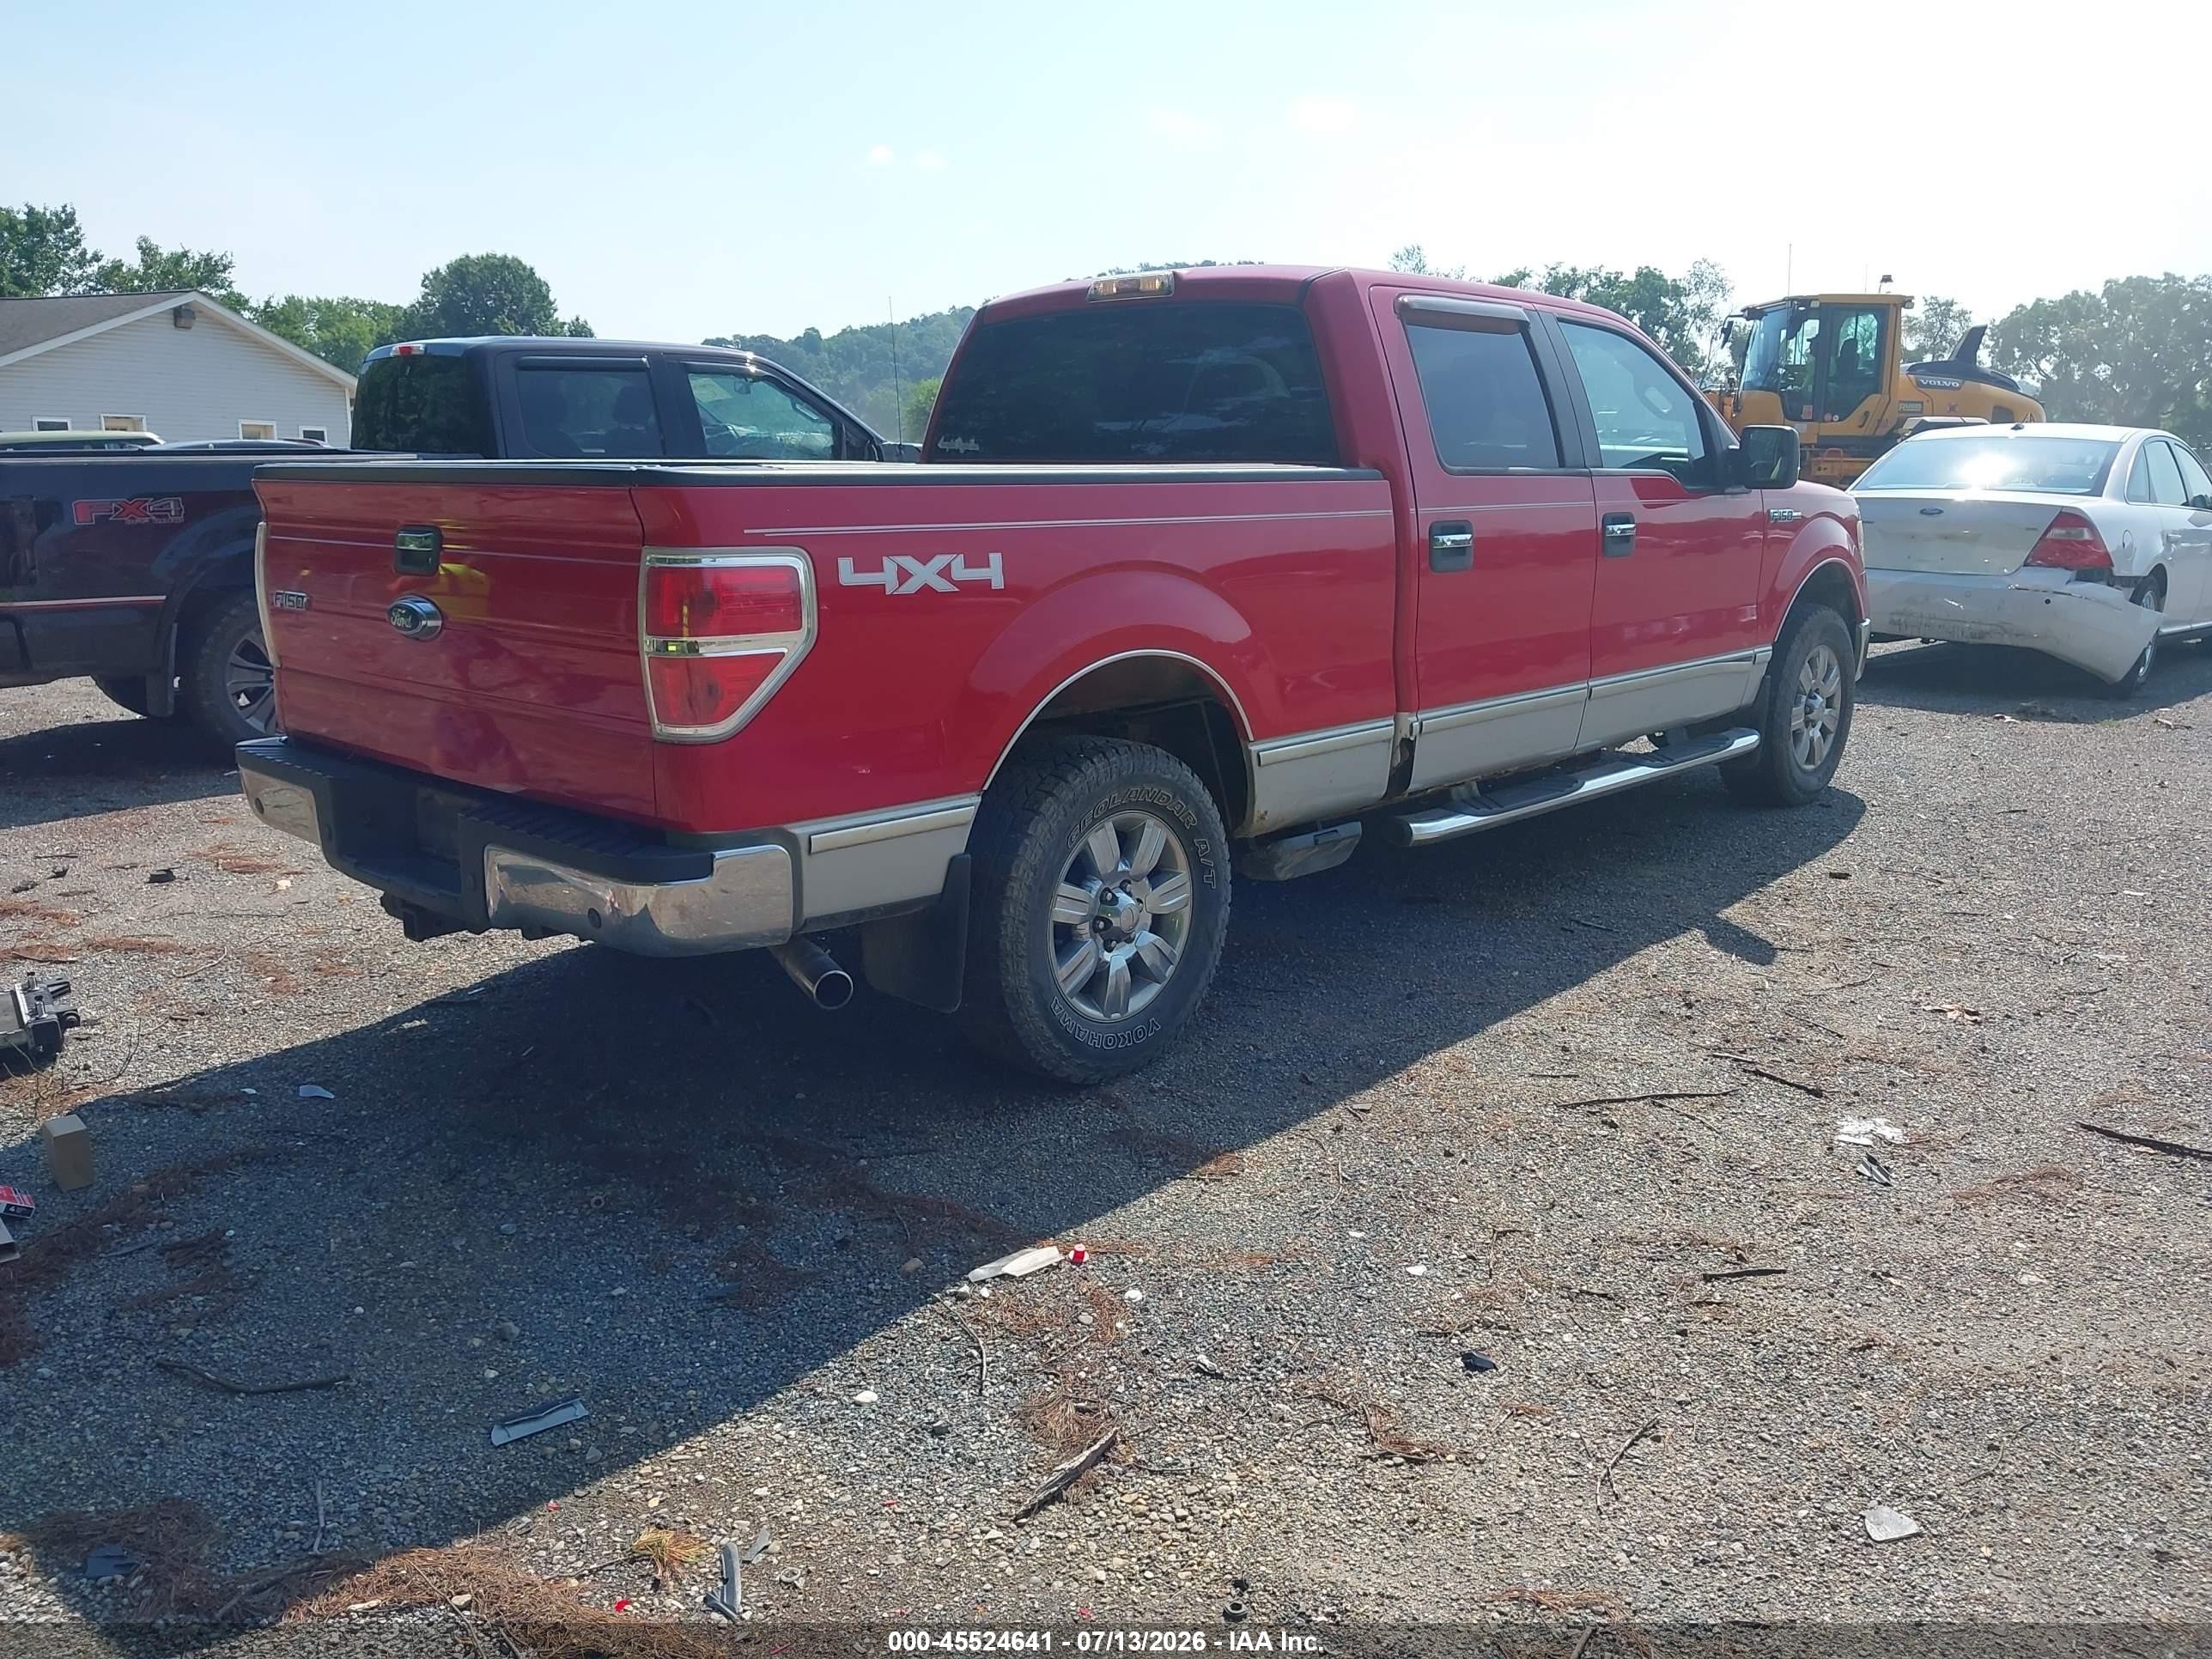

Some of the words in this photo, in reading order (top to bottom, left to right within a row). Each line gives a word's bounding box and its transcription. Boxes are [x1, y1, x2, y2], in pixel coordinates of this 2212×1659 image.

[1920, 379, 1960, 388] VOLVO
[72, 497, 185, 525] FX4
[838, 552, 1004, 595] 4X4
[391, 608, 413, 629] Ford
[1067, 787, 1198, 848] GEOLANDAR
[1194, 838, 1217, 889] A/T
[1050, 996, 1161, 1049] YOKOHAMA
